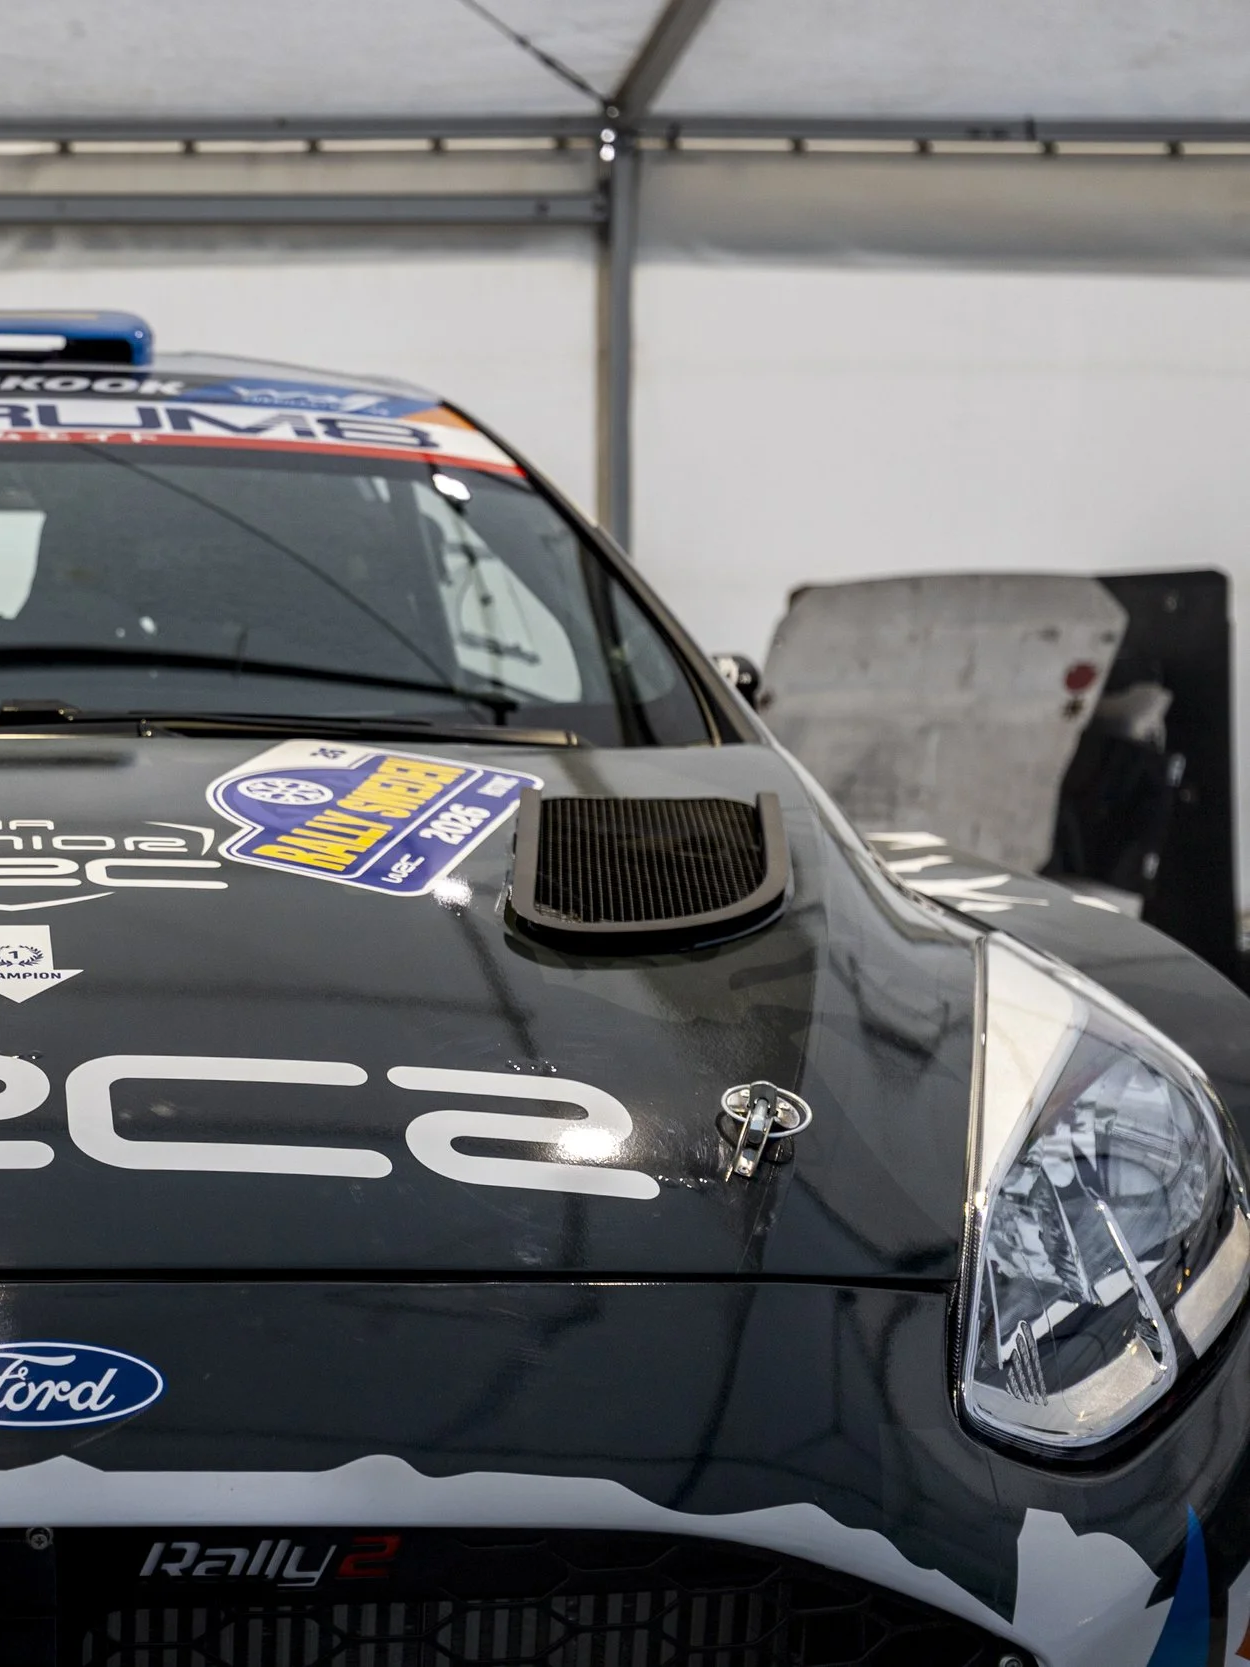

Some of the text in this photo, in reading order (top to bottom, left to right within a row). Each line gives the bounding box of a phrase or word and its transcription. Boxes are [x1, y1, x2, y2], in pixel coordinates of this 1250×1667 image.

[252, 756, 466, 872] RALLY SWEDEN
[419, 803, 491, 846] 2026
[380, 853, 426, 883] WRC
[8, 950, 19, 959] 1
